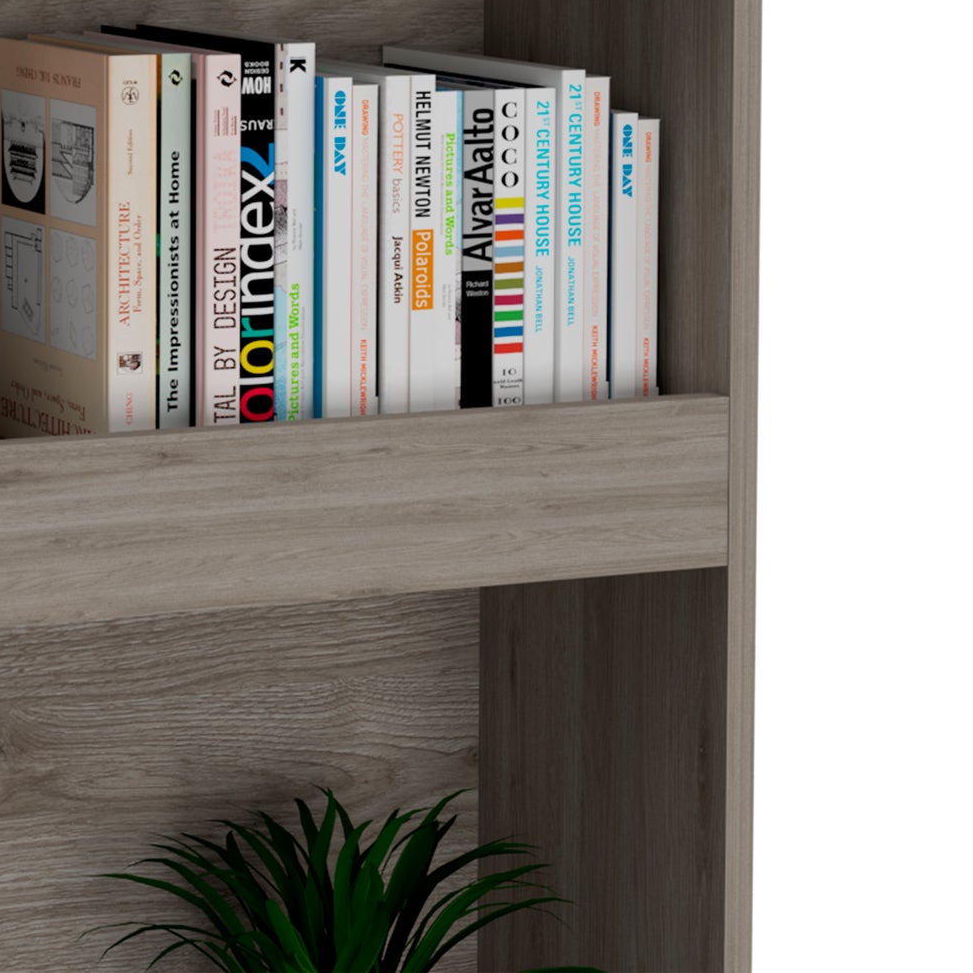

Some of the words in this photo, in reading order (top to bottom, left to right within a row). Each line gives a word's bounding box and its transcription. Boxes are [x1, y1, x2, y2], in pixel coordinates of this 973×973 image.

[242, 76, 272, 94] HOW
[334, 90, 346, 129] ONE
[415, 91, 431, 150] HELMUT
[593, 91, 601, 126] DRAWING
[334, 137, 346, 176] DAY
[392, 113, 404, 175] POTTERY
[445, 132, 456, 187] Pictures
[463, 108, 494, 185] Aalto
[568, 114, 582, 188] CENTURY
[623, 124, 633, 158] ONE
[169, 150, 180, 204] Home
[535, 128, 550, 200] CENTURY
[622, 164, 633, 198] DAY
[392, 178, 403, 214] basics
[415, 156, 431, 218] NEWTON
[445, 190, 455, 213] and
[133, 214, 142, 240] Order
[169, 210, 179, 229] at
[445, 215, 455, 256] Words
[462, 187, 494, 262] Alvar
[535, 204, 550, 257] HOUSE
[568, 192, 582, 247] HOUSE
[118, 202, 130, 327] ARCHITECTURE
[133, 242, 142, 256] and
[392, 236, 404, 270] Jacqui
[415, 231, 431, 308] Polaroids
[214, 248, 236, 329] DESIGN
[240, 142, 275, 422] olorindex2
[394, 273, 404, 304] Atkin
[535, 266, 543, 312] JONATHAN
[567, 256, 575, 305] JONATHAN
[167, 235, 181, 371] Impressionists
[289, 283, 300, 330] Words
[535, 313, 543, 333] BELL
[567, 305, 575, 326] BELL
[214, 345, 236, 370] BY
[289, 332, 300, 359] and
[167, 379, 178, 413] The
[214, 385, 236, 424] TAL
[288, 367, 300, 421] Pictures
